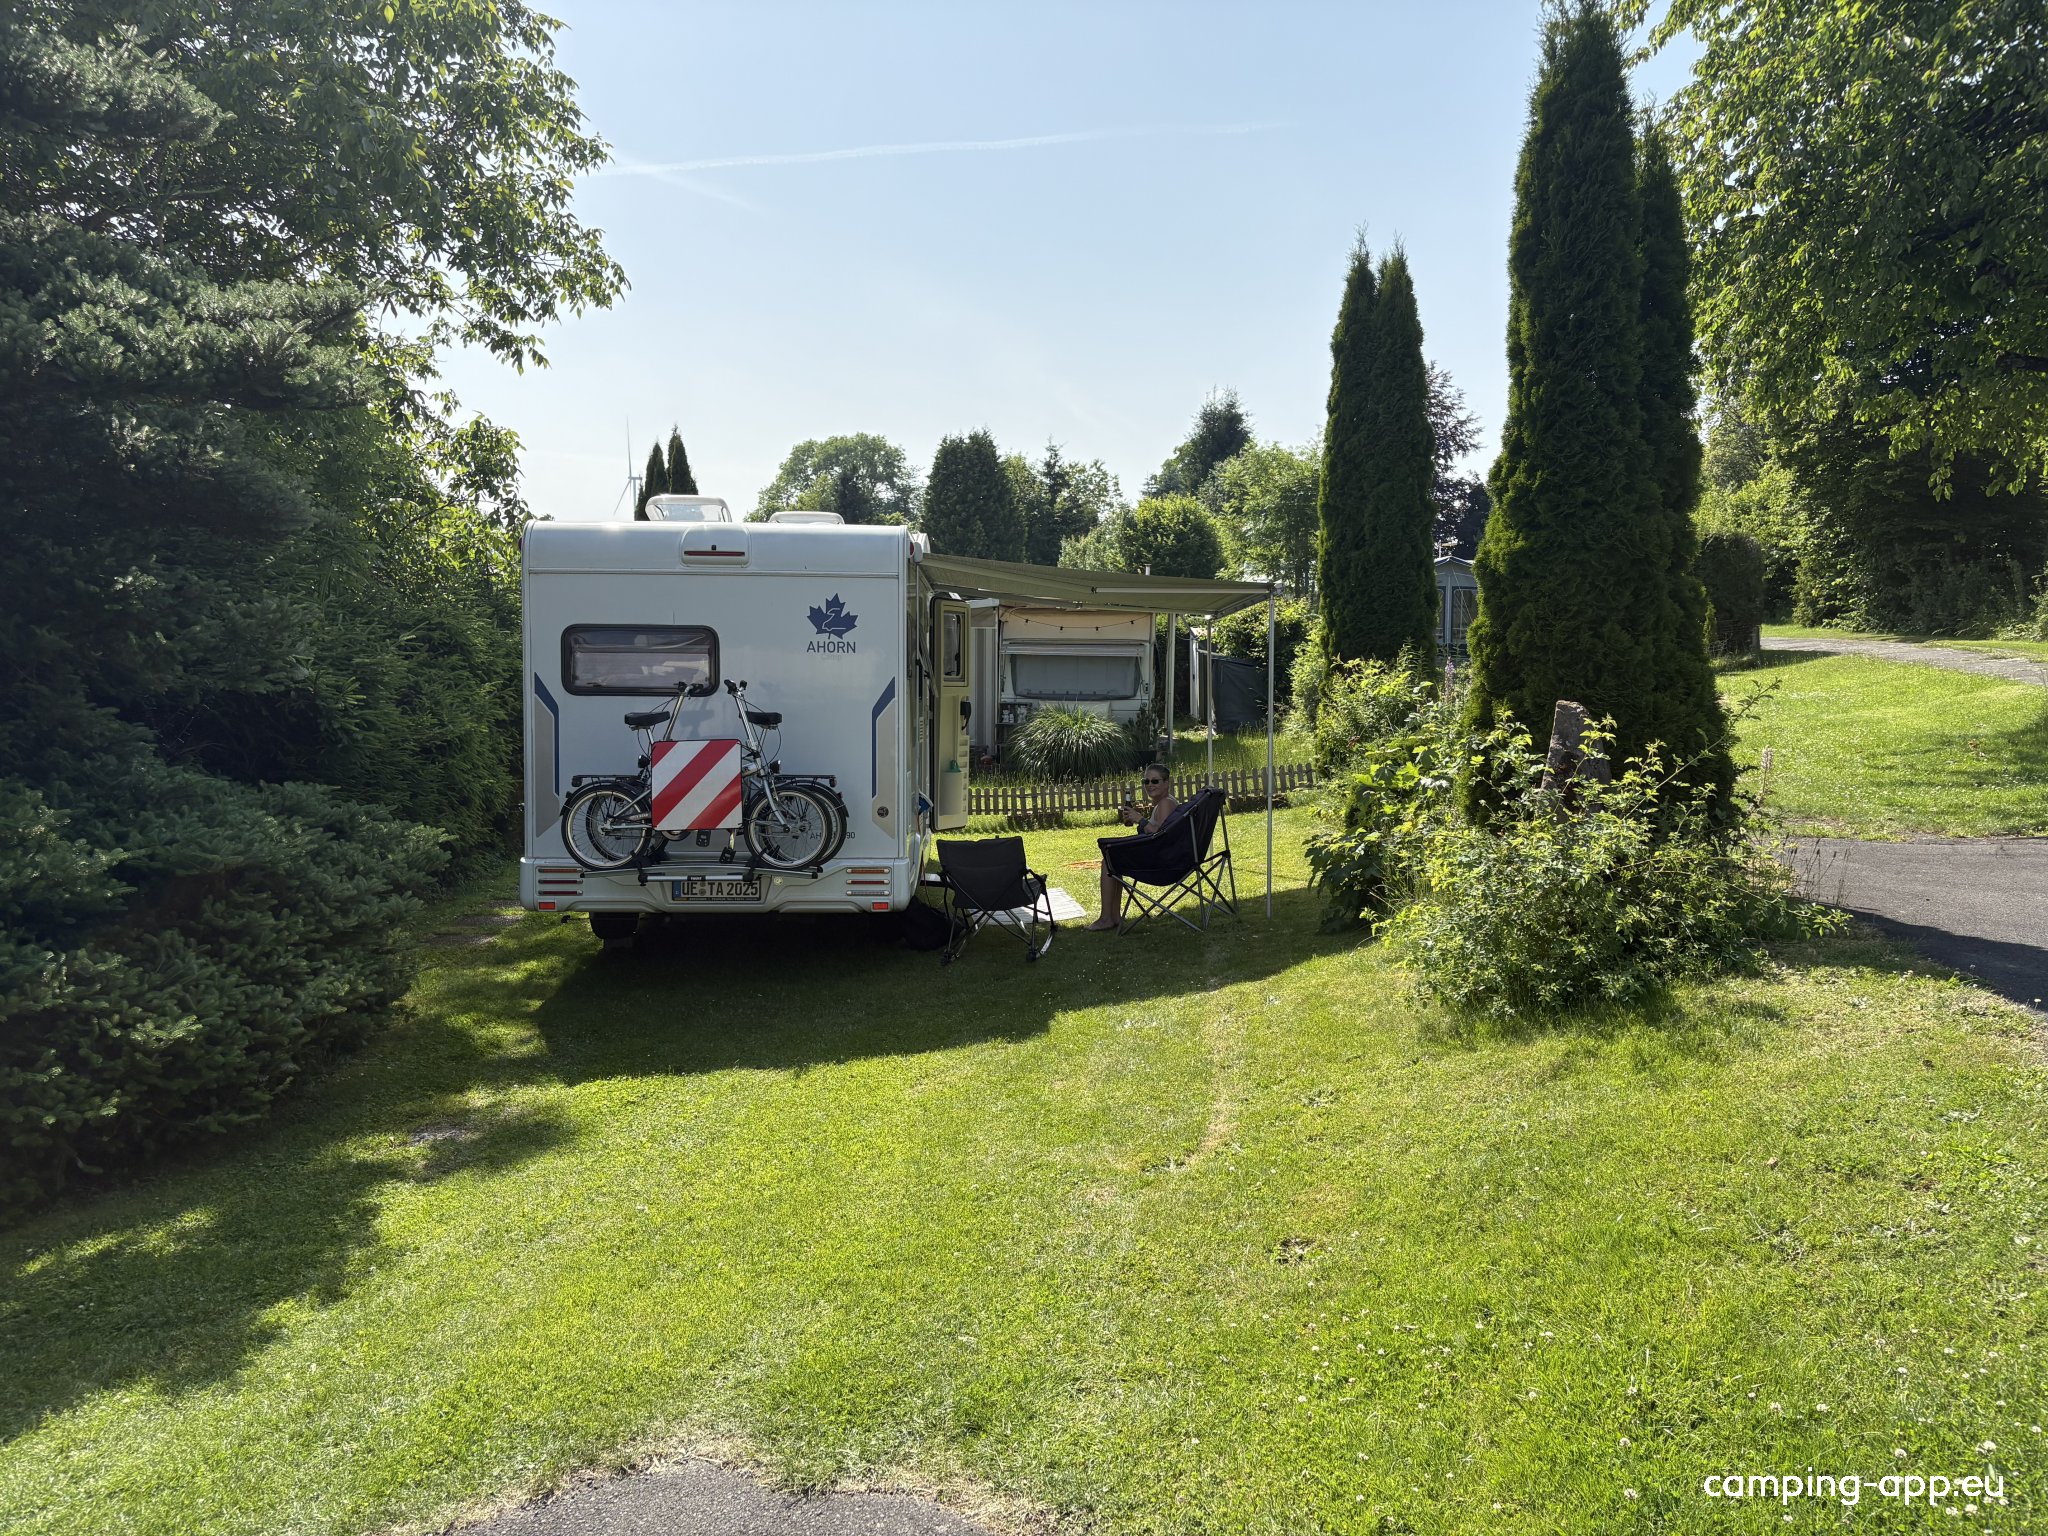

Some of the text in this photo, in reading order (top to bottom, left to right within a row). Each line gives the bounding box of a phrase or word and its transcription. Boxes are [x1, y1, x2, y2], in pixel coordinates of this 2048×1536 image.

[806, 640, 856, 654] AHORN
[681, 881, 759, 896] UE TA 2025
